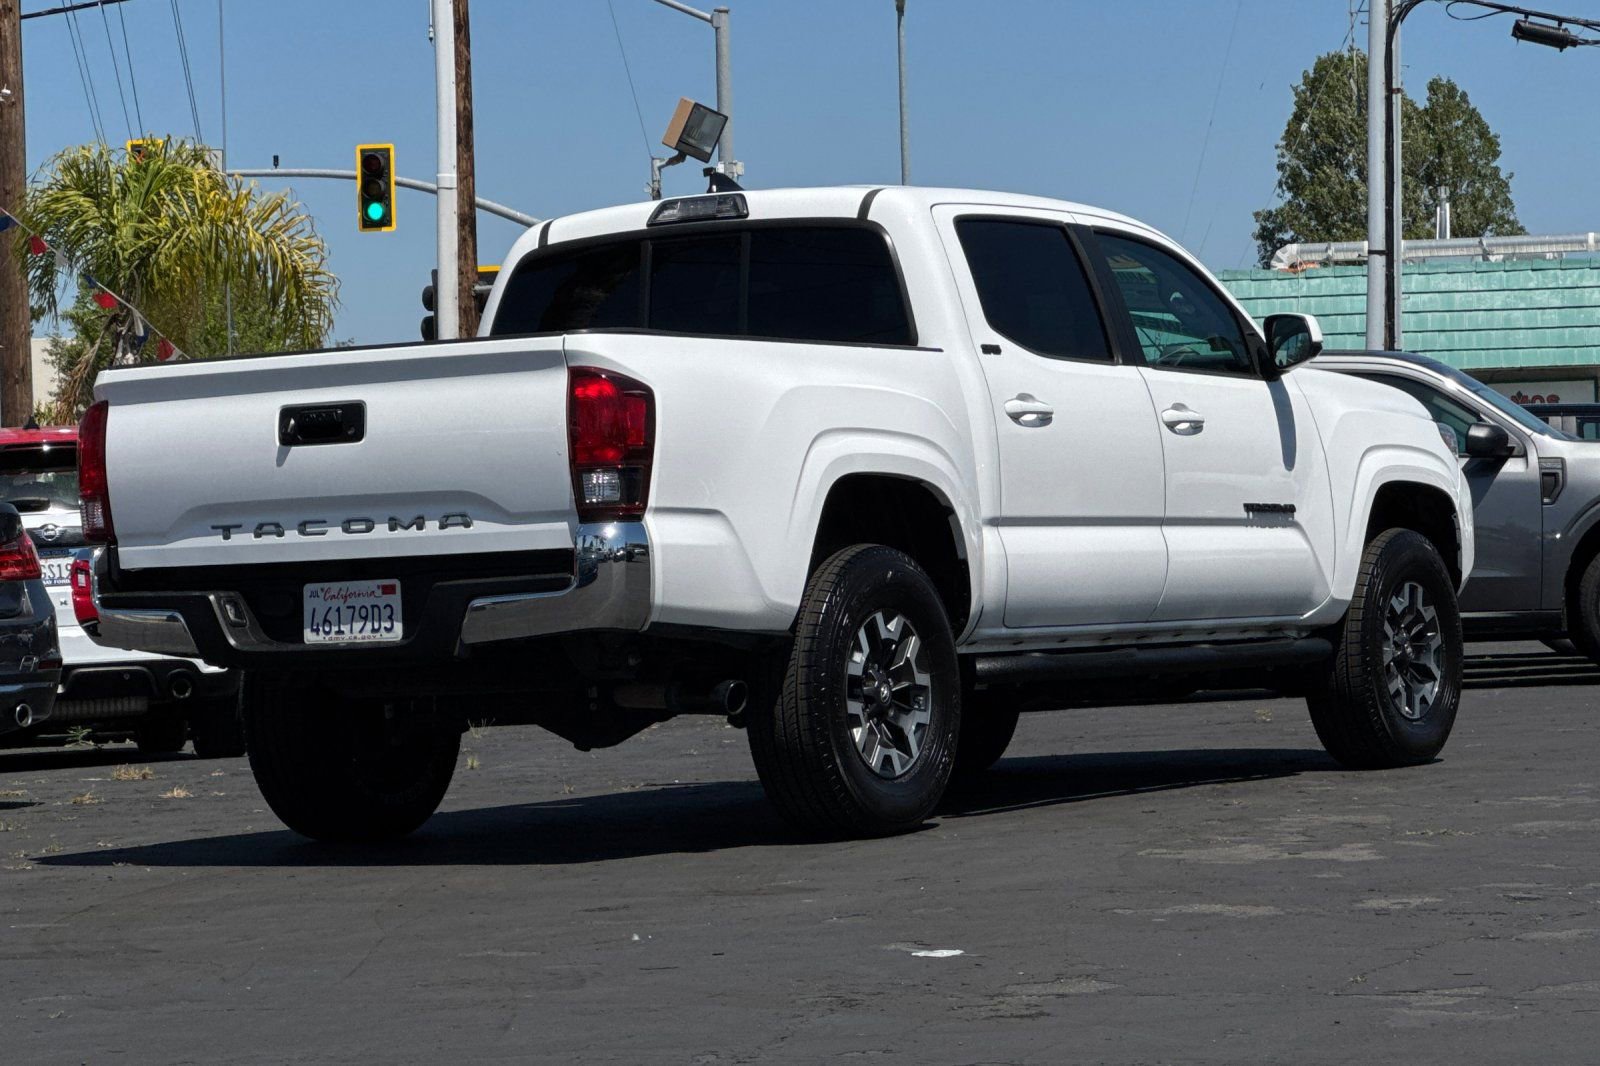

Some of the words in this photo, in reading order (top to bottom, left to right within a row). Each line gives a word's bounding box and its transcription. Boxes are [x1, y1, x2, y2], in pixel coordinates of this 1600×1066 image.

[211, 512, 474, 541] TACOMA
[309, 589, 320, 598] JUL
[323, 586, 383, 604] California
[310, 603, 395, 636] 46179D3
